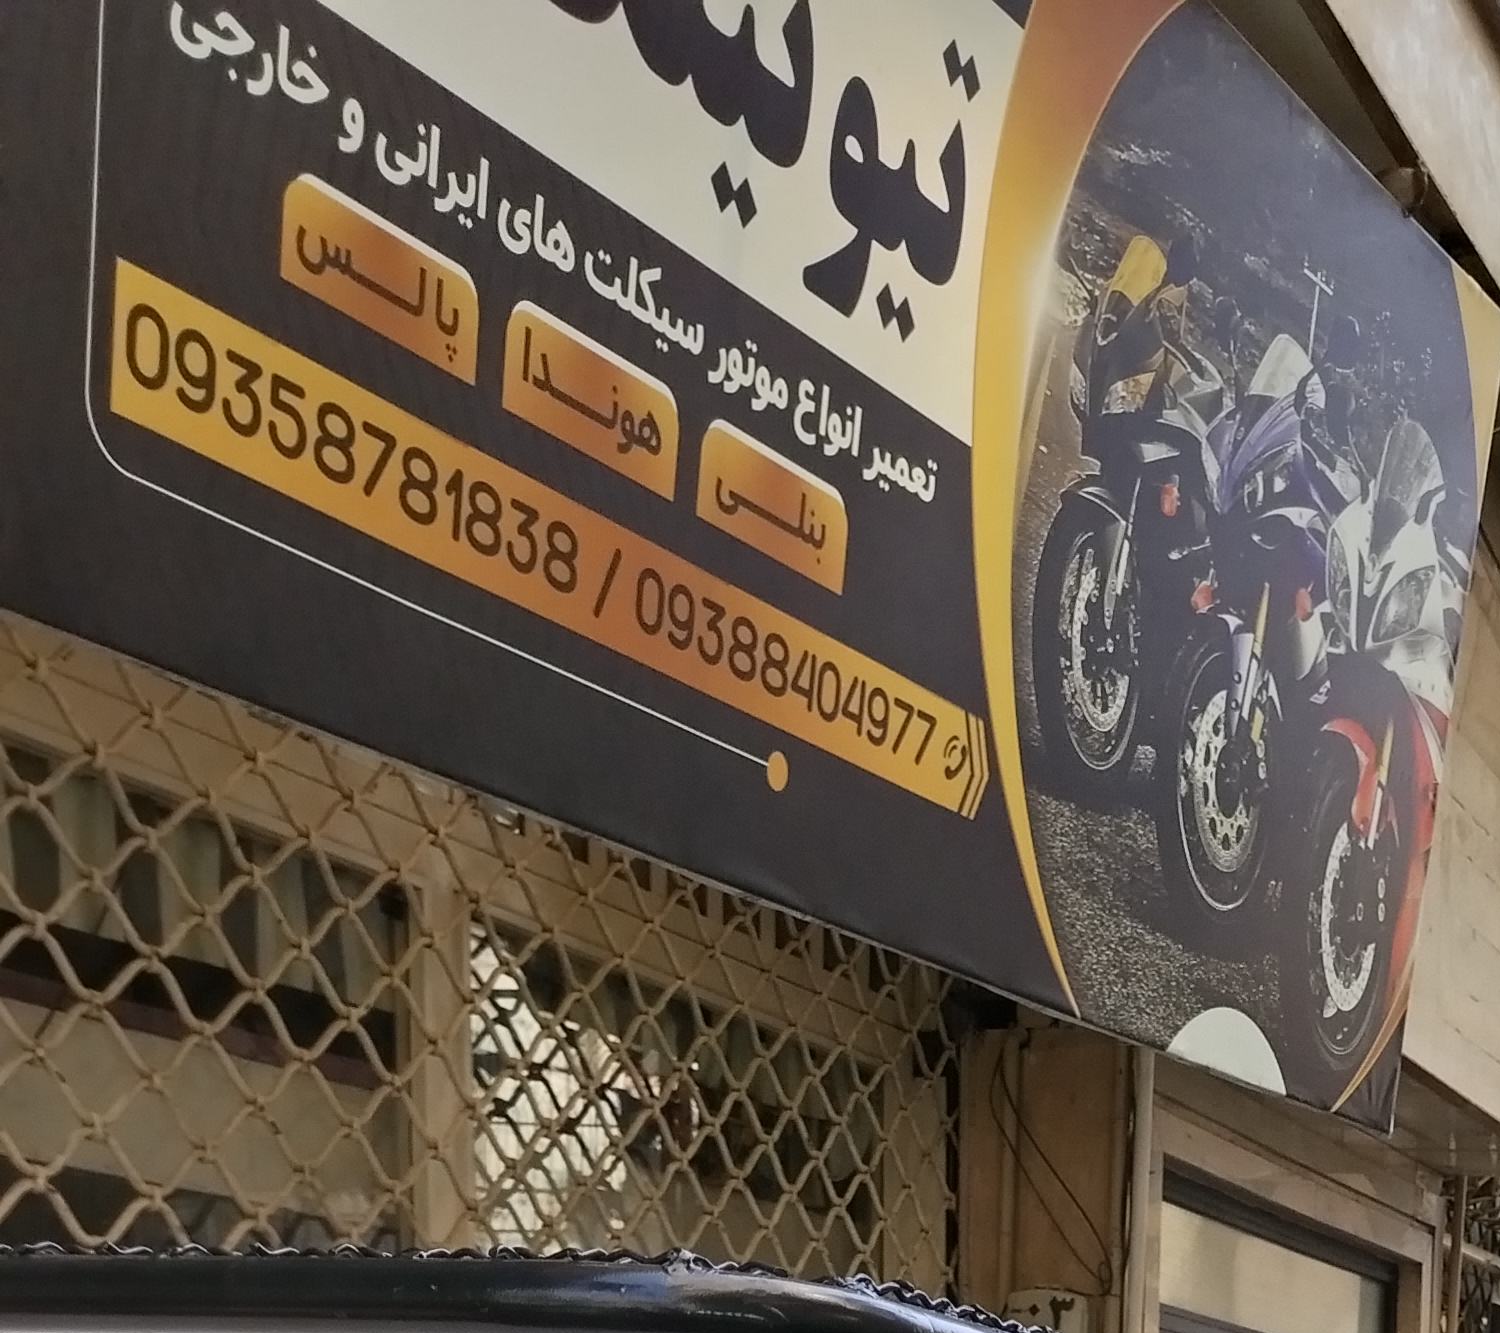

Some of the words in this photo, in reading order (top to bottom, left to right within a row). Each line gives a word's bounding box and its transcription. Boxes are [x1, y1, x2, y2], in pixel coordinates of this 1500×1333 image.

[170, 1, 330, 103] خارجی
[338, 98, 364, 152] و
[375, 124, 489, 229] ایرانی
[498, 194, 575, 272] های
[296, 224, 459, 363] پالس
[584, 249, 704, 355] سیکلت
[522, 325, 662, 457] هوندا
[708, 339, 788, 411] موتور
[793, 378, 863, 457] انواع
[715, 475, 827, 565] بنلی
[862, 447, 938, 502] تعمیر
[126, 302, 578, 593] 09358781838
[635, 568, 937, 765] 09388404977
